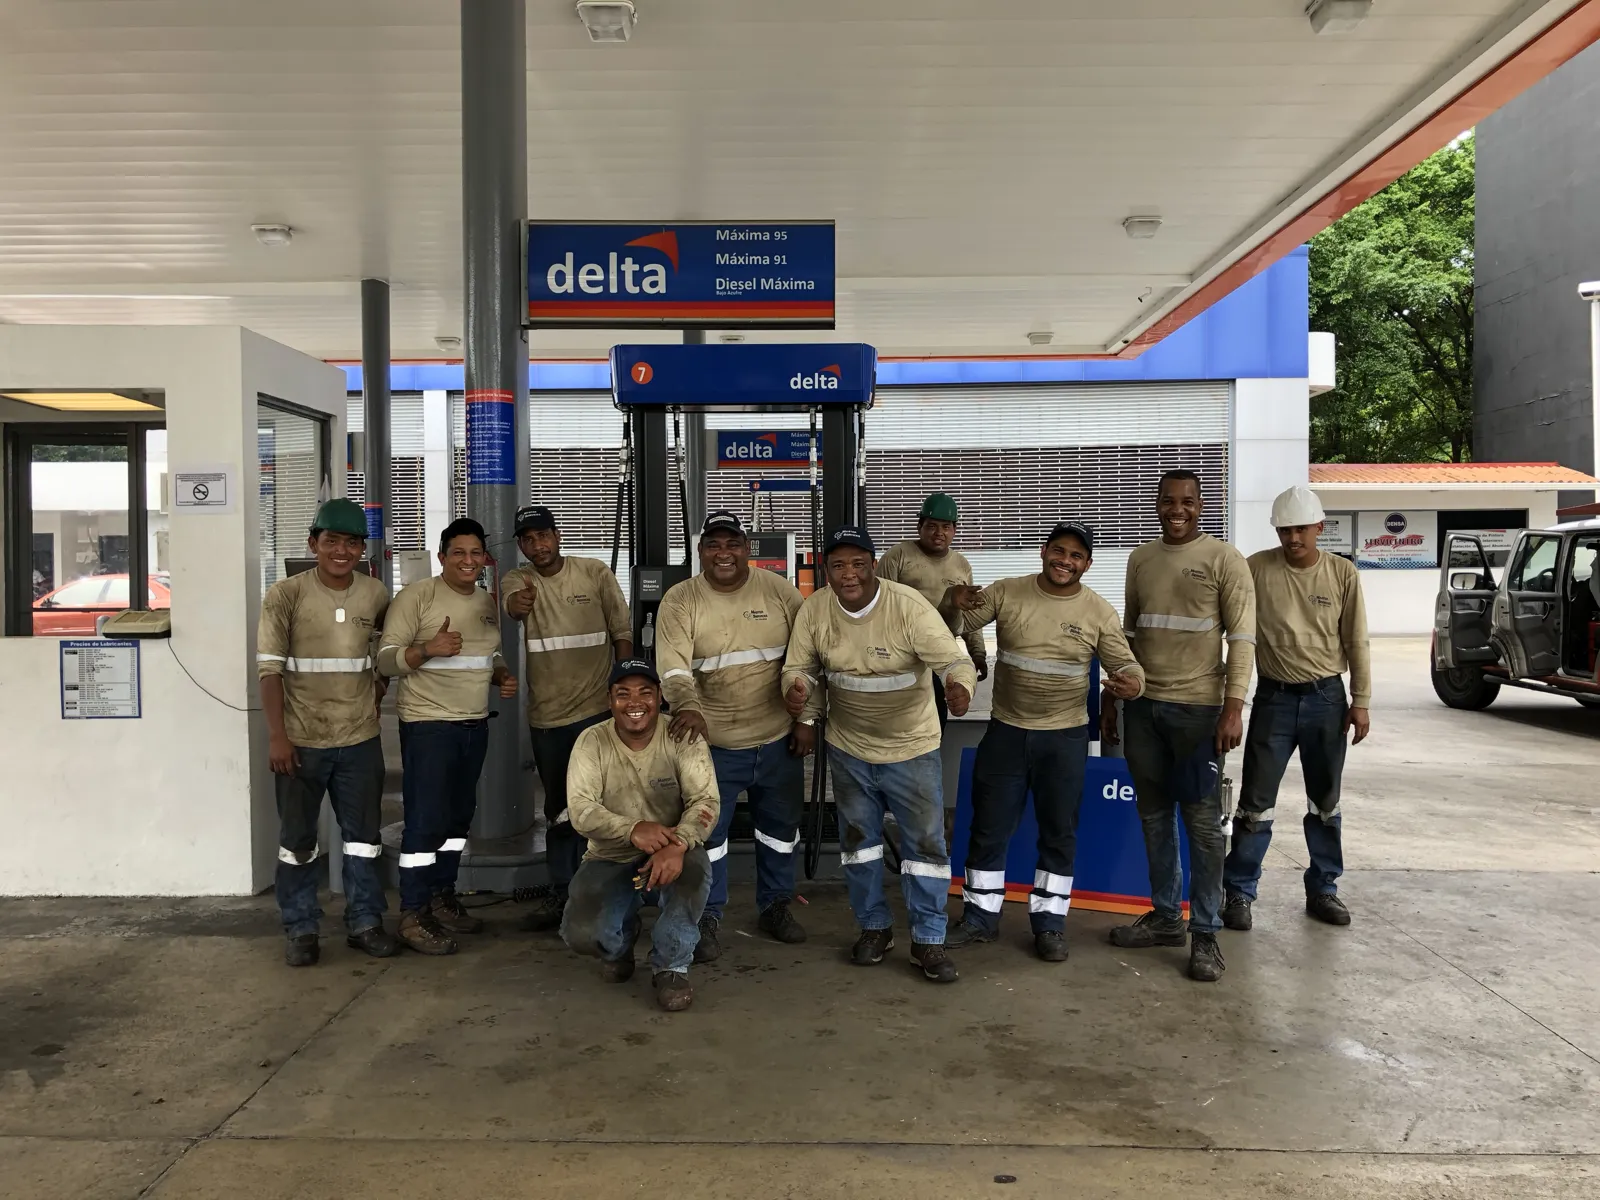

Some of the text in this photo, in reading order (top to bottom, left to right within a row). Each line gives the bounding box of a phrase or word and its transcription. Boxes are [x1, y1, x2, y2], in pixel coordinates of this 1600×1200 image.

[716, 229, 788, 241] Máxima 95
[716, 253, 787, 265] Máxima 91
[547, 252, 667, 294] delta
[716, 277, 815, 290] Diesel Máxima
[637, 367, 646, 381] 7
[789, 372, 838, 390] delta
[725, 441, 773, 458] delta
